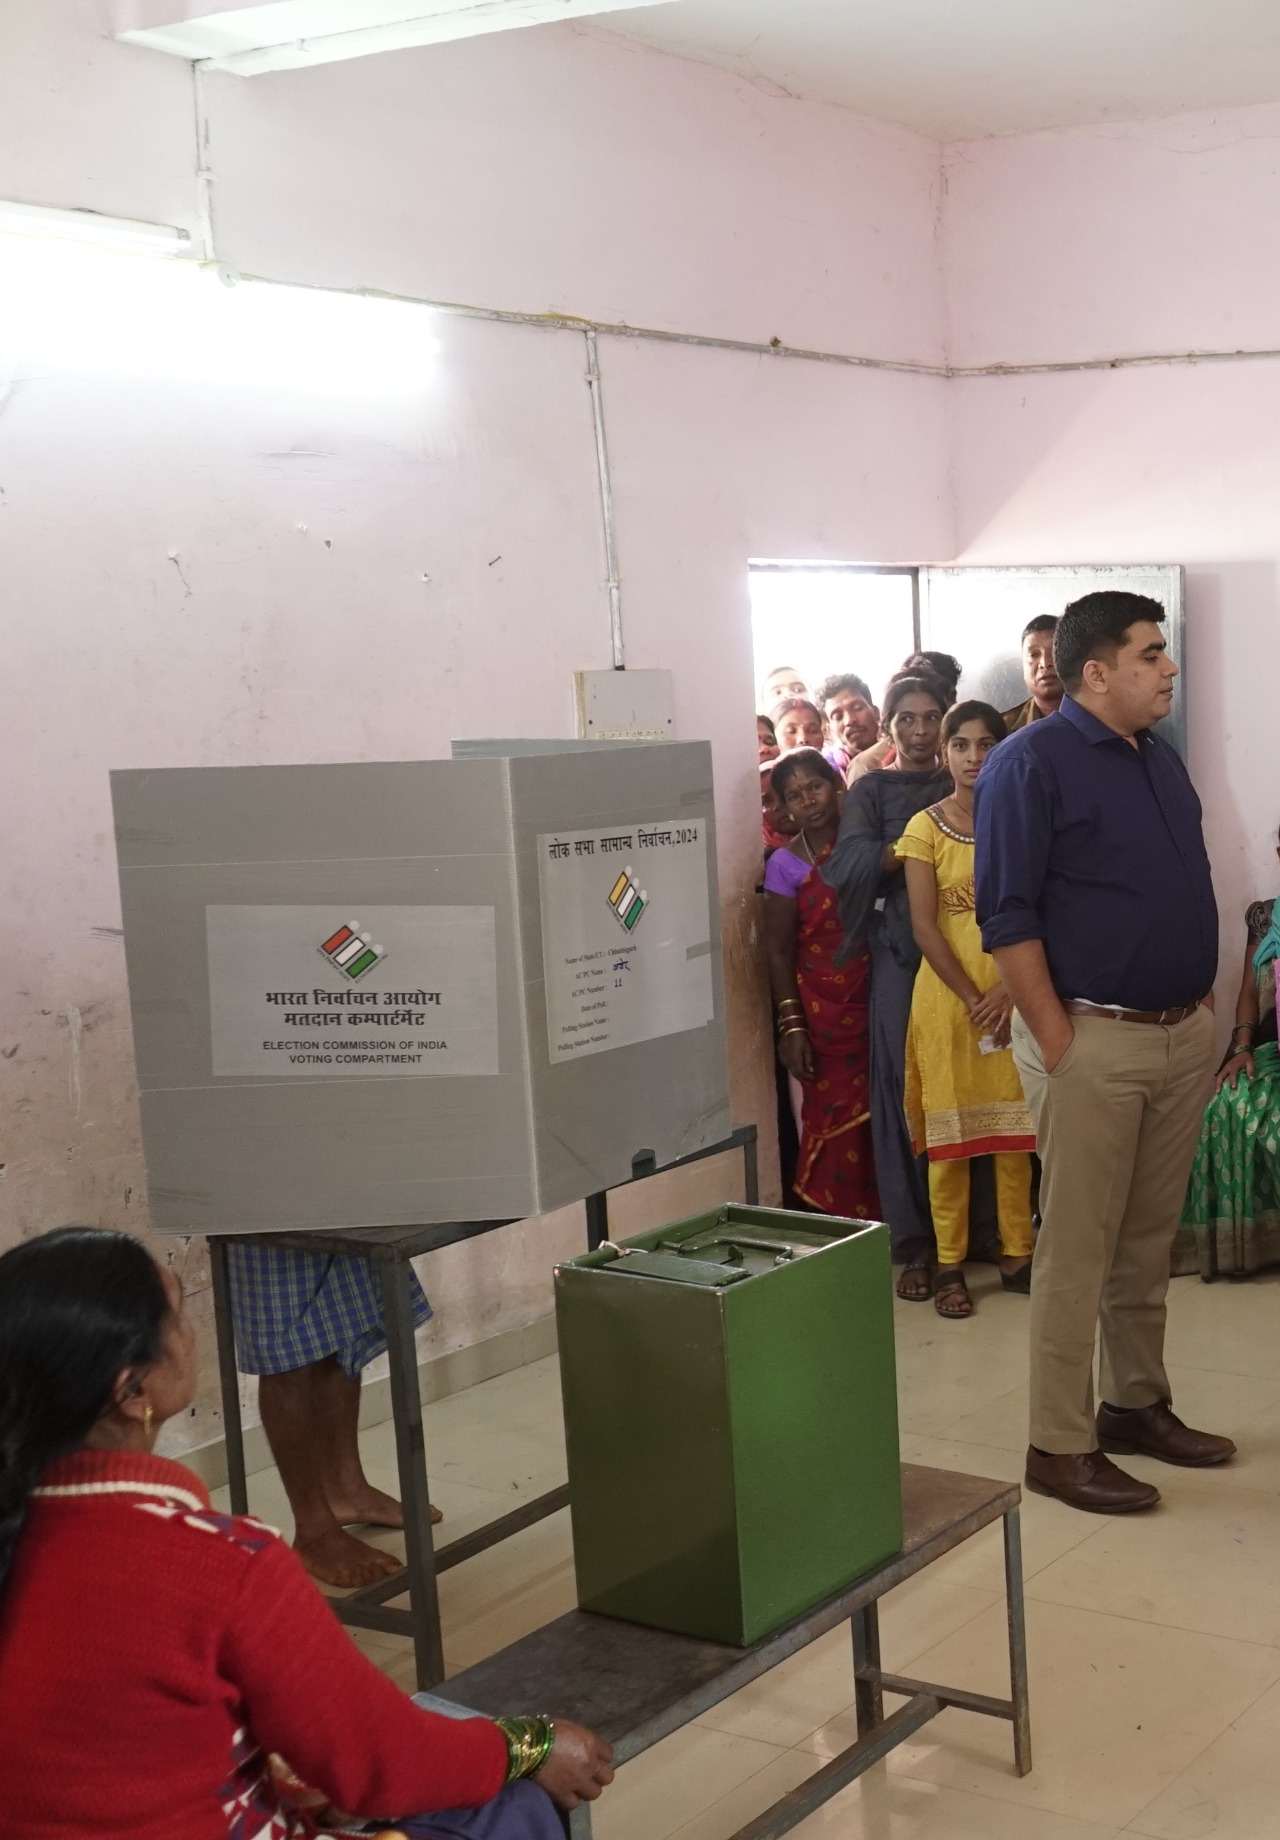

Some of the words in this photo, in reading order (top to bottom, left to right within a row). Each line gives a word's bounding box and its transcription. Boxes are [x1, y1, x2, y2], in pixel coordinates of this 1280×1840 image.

[548, 838, 570, 859] लोक
[574, 839, 595, 856] सभा
[600, 835, 632, 852] सामान्य
[265, 991, 309, 1005] भारत
[312, 988, 379, 1006] निर्वाचन
[383, 988, 442, 1006] आयोग
[284, 1012, 343, 1027] मतदान
[263, 1040, 321, 1050] ELECTION
[322, 1040, 396, 1050] COMMISSION
[399, 1040, 415, 1050] OF
[417, 1040, 448, 1050] INDIA
[289, 1054, 333, 1064] VOTING
[335, 1054, 423, 1064] COMPARTMENT
